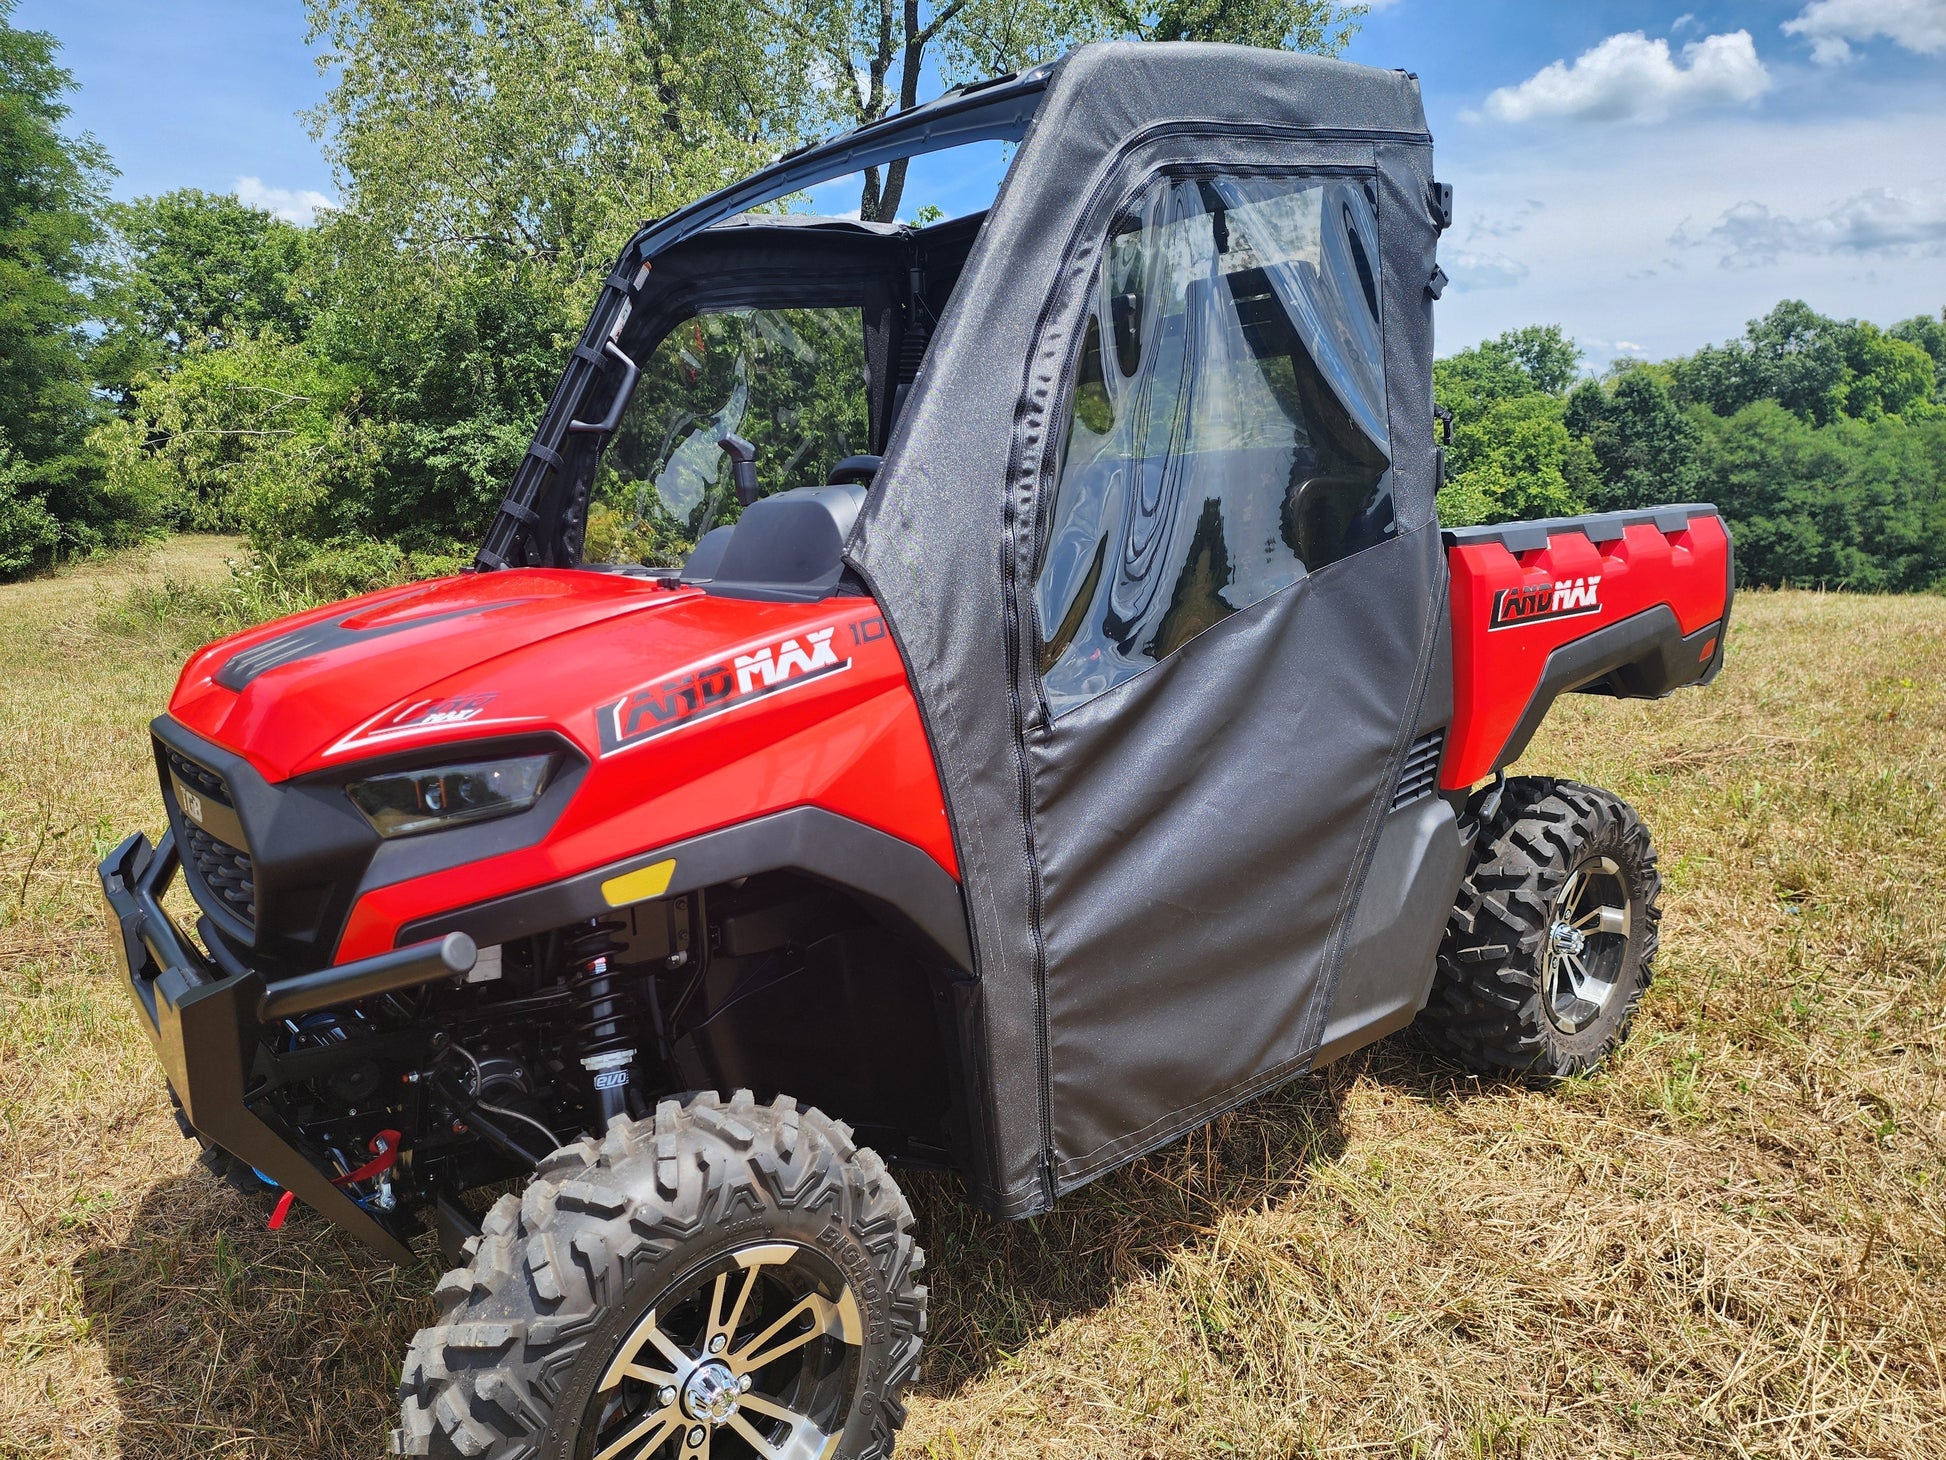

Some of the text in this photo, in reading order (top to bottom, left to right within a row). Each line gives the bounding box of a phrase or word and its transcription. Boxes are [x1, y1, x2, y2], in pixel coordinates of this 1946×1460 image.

[1487, 575, 1603, 632] LANDMAX
[595, 627, 853, 760] LANDMAX
[815, 1223, 886, 1345] BIGHORN
